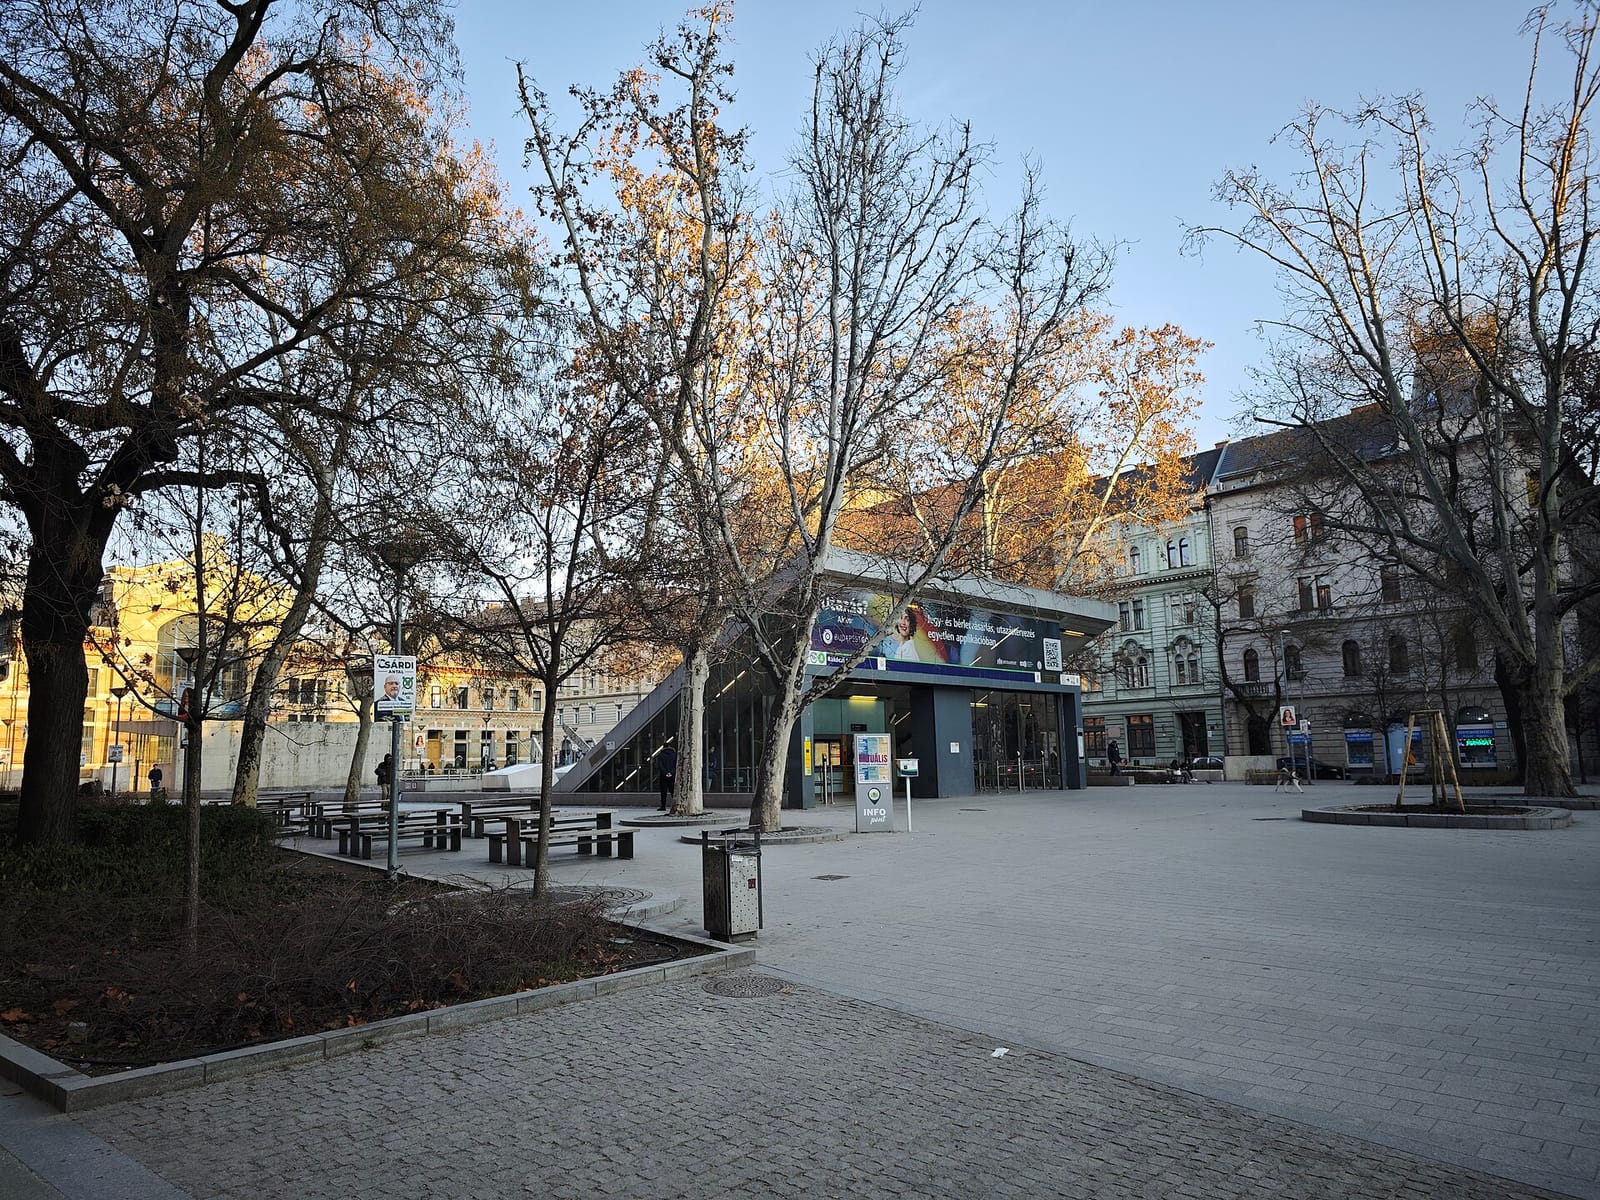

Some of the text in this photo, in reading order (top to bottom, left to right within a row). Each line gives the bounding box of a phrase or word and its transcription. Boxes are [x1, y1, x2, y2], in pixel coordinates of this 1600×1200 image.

[944, 617, 953, 627] és
[927, 630, 955, 642] egyetlen
[377, 658, 414, 670] CSÁRDI
[863, 808, 886, 816] INFO
